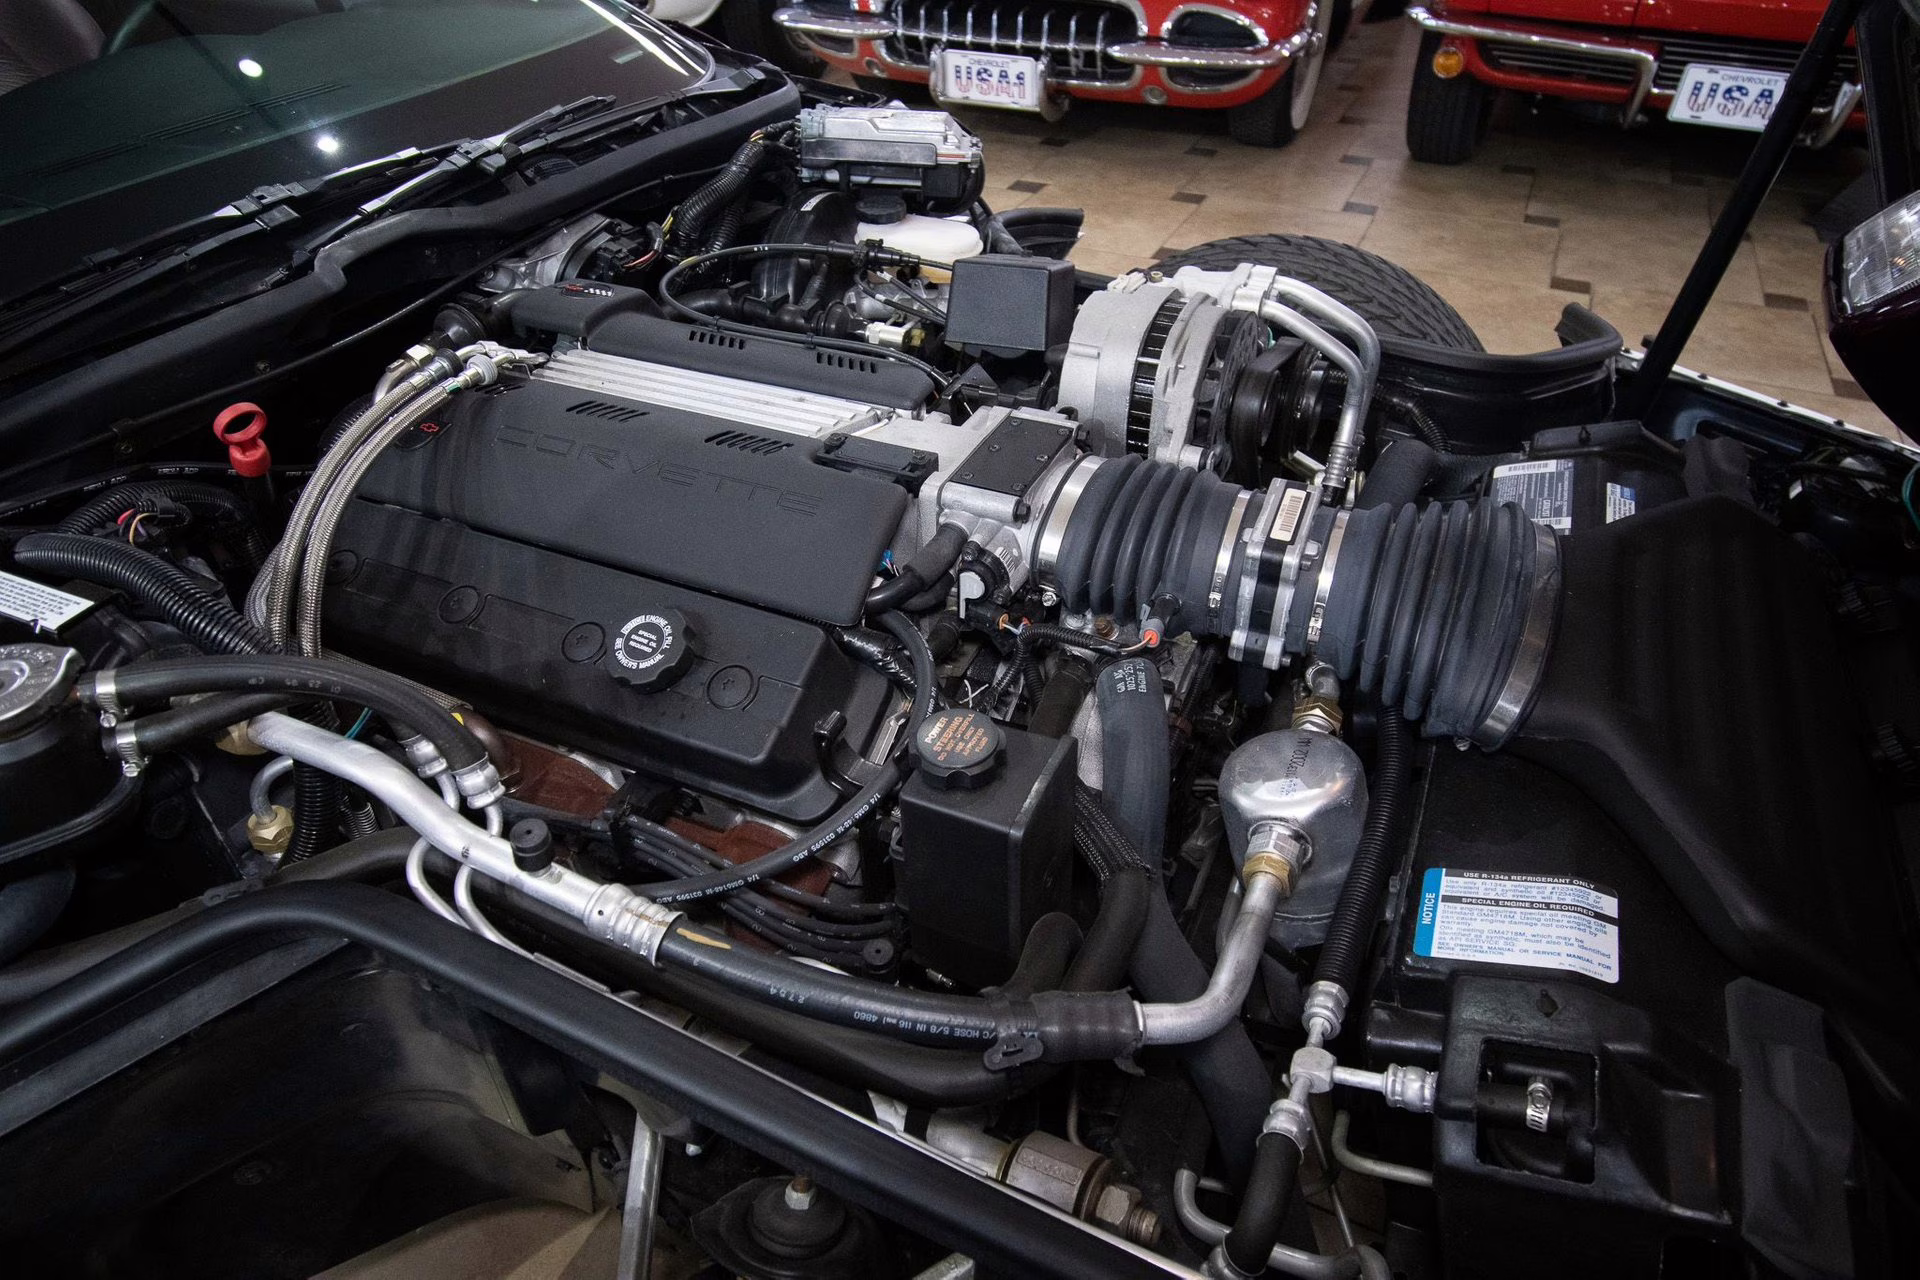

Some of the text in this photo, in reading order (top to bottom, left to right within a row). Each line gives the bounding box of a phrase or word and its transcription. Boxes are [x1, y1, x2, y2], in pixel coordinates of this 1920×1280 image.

[968, 58, 1010, 68] CHEVROLET
[954, 65, 1026, 99] USA1
[1721, 73, 1779, 86] CHEVROLET
[496, 424, 823, 517] CORVETTE
[631, 635, 649, 645] ENGINE
[638, 630, 657, 640] SPECIAL
[646, 615, 668, 627] ENGINE
[663, 636, 673, 649] FILL
[628, 641, 652, 653] REQUIRED
[639, 653, 664, 669] MANUAL
[924, 717, 948, 744] POWER
[933, 716, 963, 752] STEERING
[963, 728, 984, 756] APPROVED
[869, 792, 882, 805] 1/4
[811, 833, 836, 851] 031595
[747, 873, 761, 883] 1/4
[1510, 882, 1547, 890] refrigerant
[1511, 875, 1570, 884] REFRIGERANT
[1573, 879, 1595, 889] ONLY
[1501, 887, 1533, 895] synthetic
[1421, 892, 1436, 925] NOTICE
[1461, 897, 1496, 906] SPECIAL
[1550, 903, 1595, 917] REQUIRED
[1441, 909, 1472, 917] Standard
[1520, 914, 1541, 923] Using
[1567, 919, 1593, 930] engine
[1487, 907, 1517, 915] requires
[1520, 910, 1547, 918] special
[1561, 912, 1591, 925] meeting
[1593, 920, 1607, 930] GM
[1457, 926, 1484, 935] meeting
[1575, 937, 1584, 945] be
[1481, 917, 1505, 925] engine
[1508, 919, 1538, 928] damage
[1556, 923, 1587, 934] covered
[1589, 930, 1598, 938] by
[1439, 930, 1471, 938] identified
[1564, 940, 1574, 948] be
[1577, 943, 1611, 960] identified
[1465, 937, 1500, 946] SERVICE
[1487, 945, 1516, 953] MANUAL
[1532, 949, 1562, 957] SERVICE
[1566, 953, 1595, 966] MANUAL
[1597, 961, 1613, 972] FOR
[916, 1022, 927, 1033] IN
[929, 1023, 949, 1035] 5/8
[954, 1027, 980, 1039] HOSE
